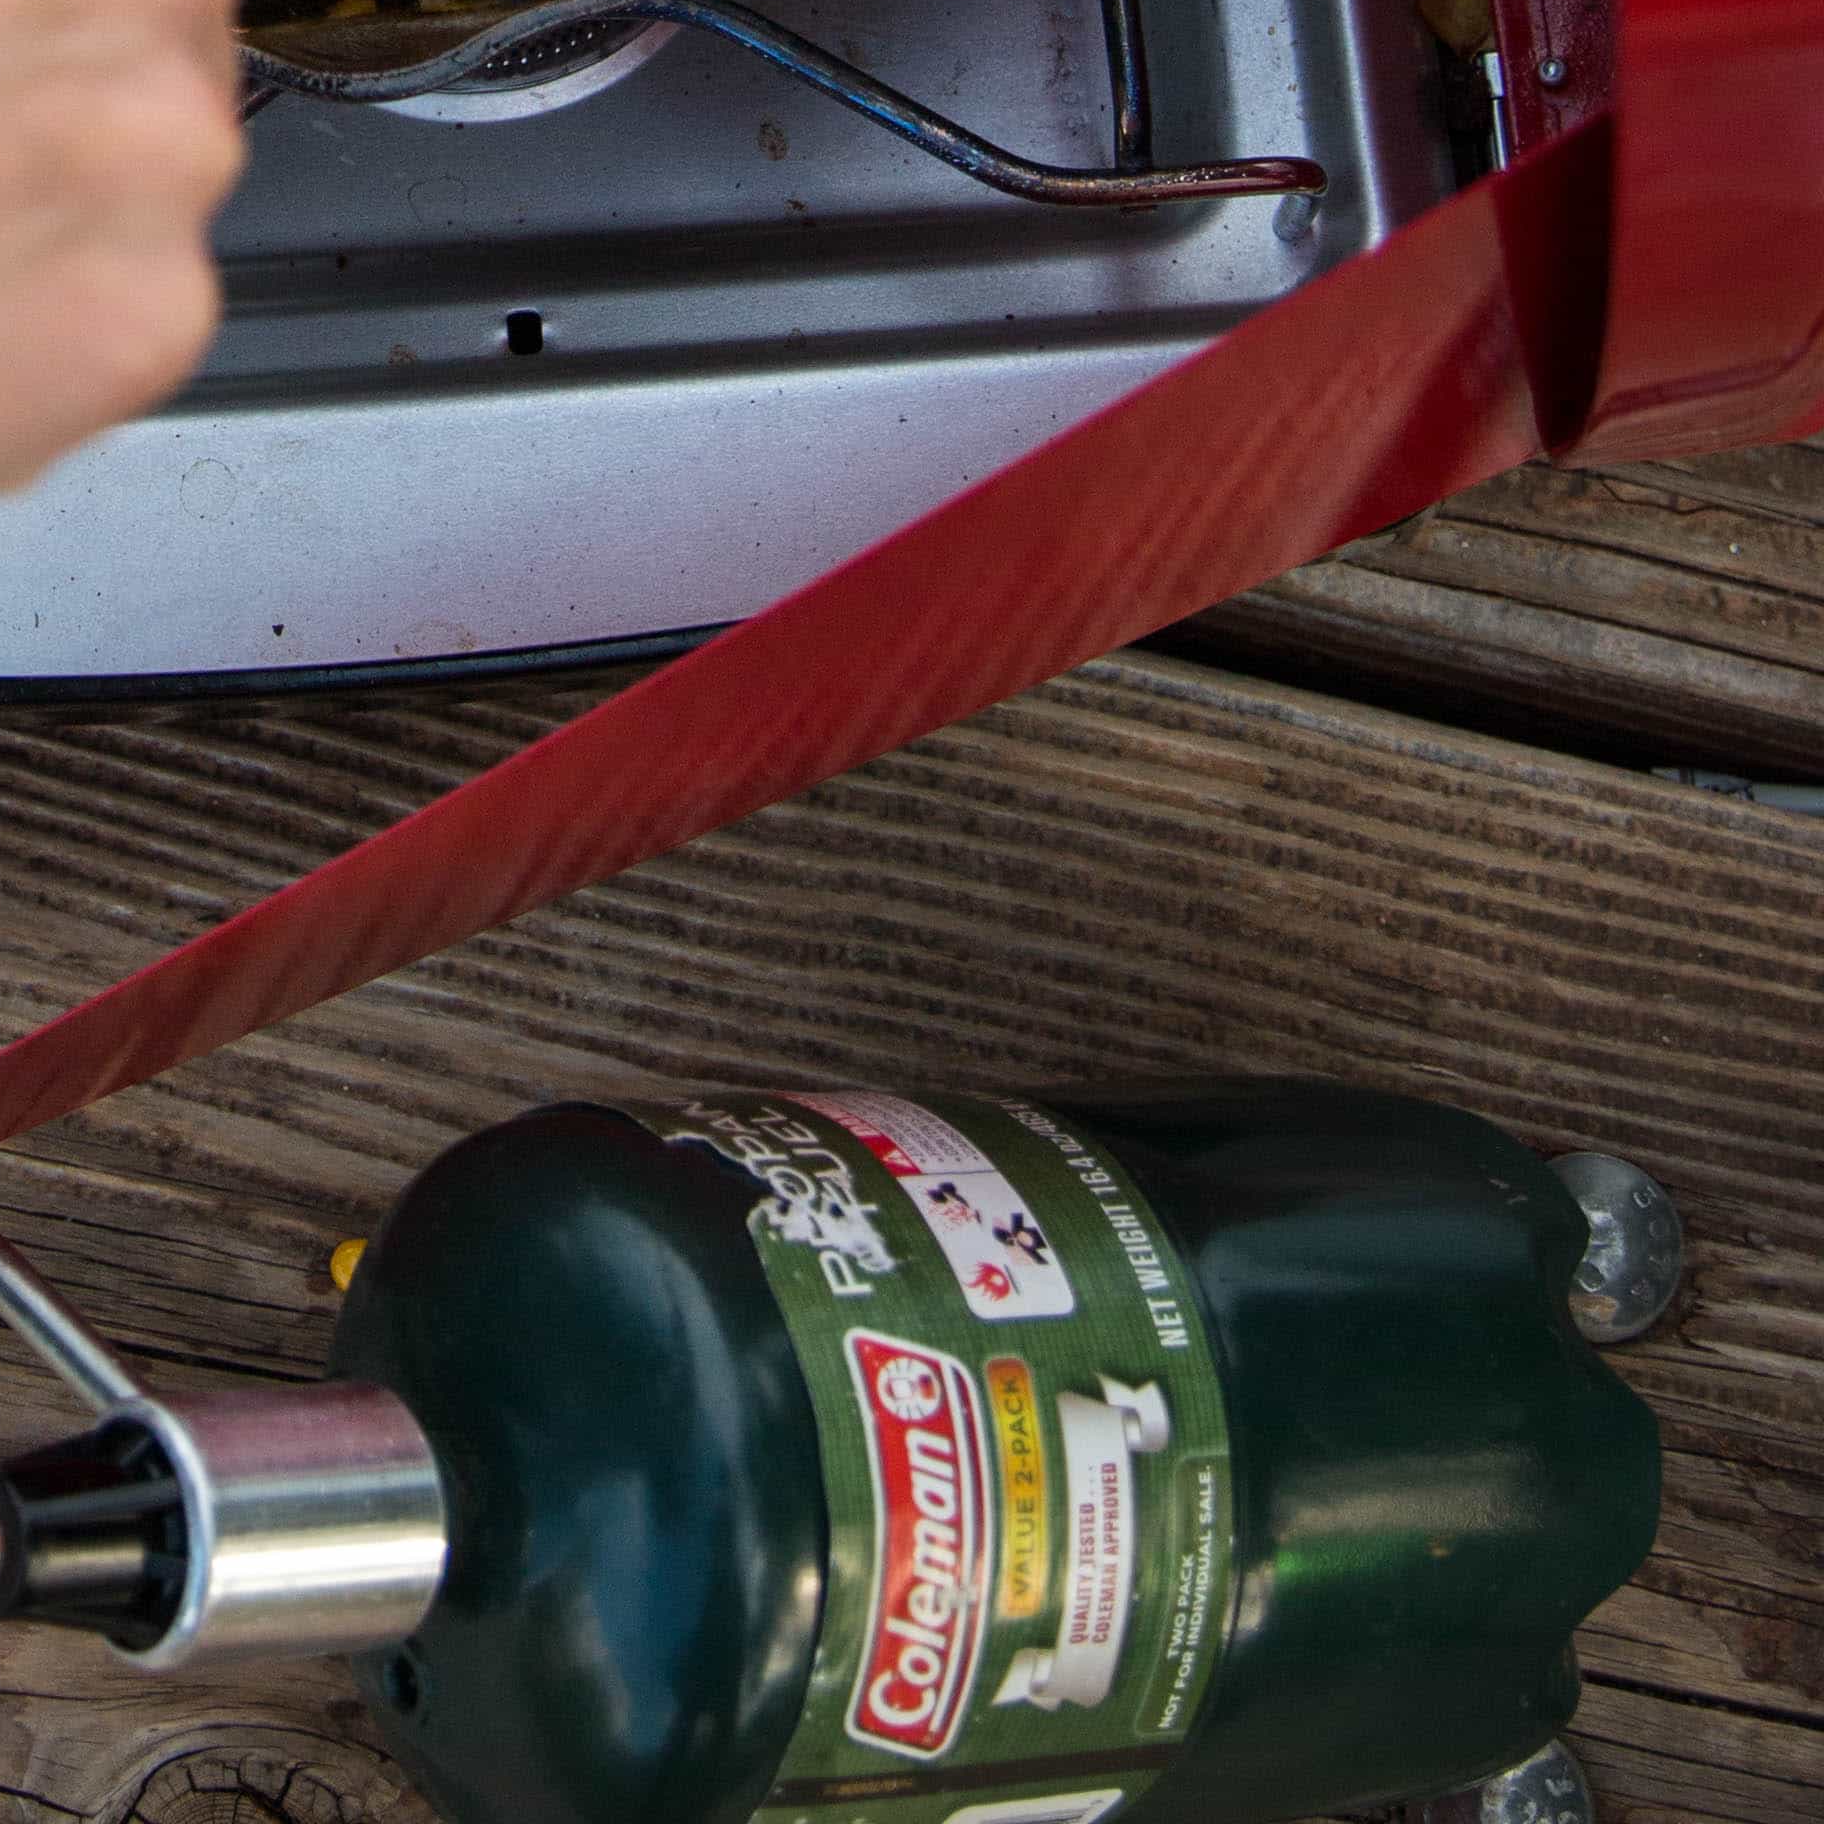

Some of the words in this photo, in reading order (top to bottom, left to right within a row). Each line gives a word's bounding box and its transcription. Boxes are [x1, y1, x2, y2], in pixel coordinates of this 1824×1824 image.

[1100, 1202, 1170, 1291] WEIGHT
[1147, 1297, 1190, 1349] NET
[1002, 1375, 1033, 1483] 2-PACK
[1101, 1462, 1120, 1555] APPROVED
[1198, 1465, 1212, 1524] SALE.
[868, 1428, 963, 1727] Coleman
[1013, 1502, 1036, 1599] VALUE
[1186, 1529, 1212, 1645] INDIVIDUAL
[1070, 1573, 1094, 1644] QUALITY
[1092, 1562, 1118, 1643] COLEMAN
[1167, 1614, 1186, 1659] TWO
[1177, 1553, 1194, 1607] PACK
[1158, 1694, 1181, 1728] NOT
[1174, 1650, 1195, 1689] FOR
